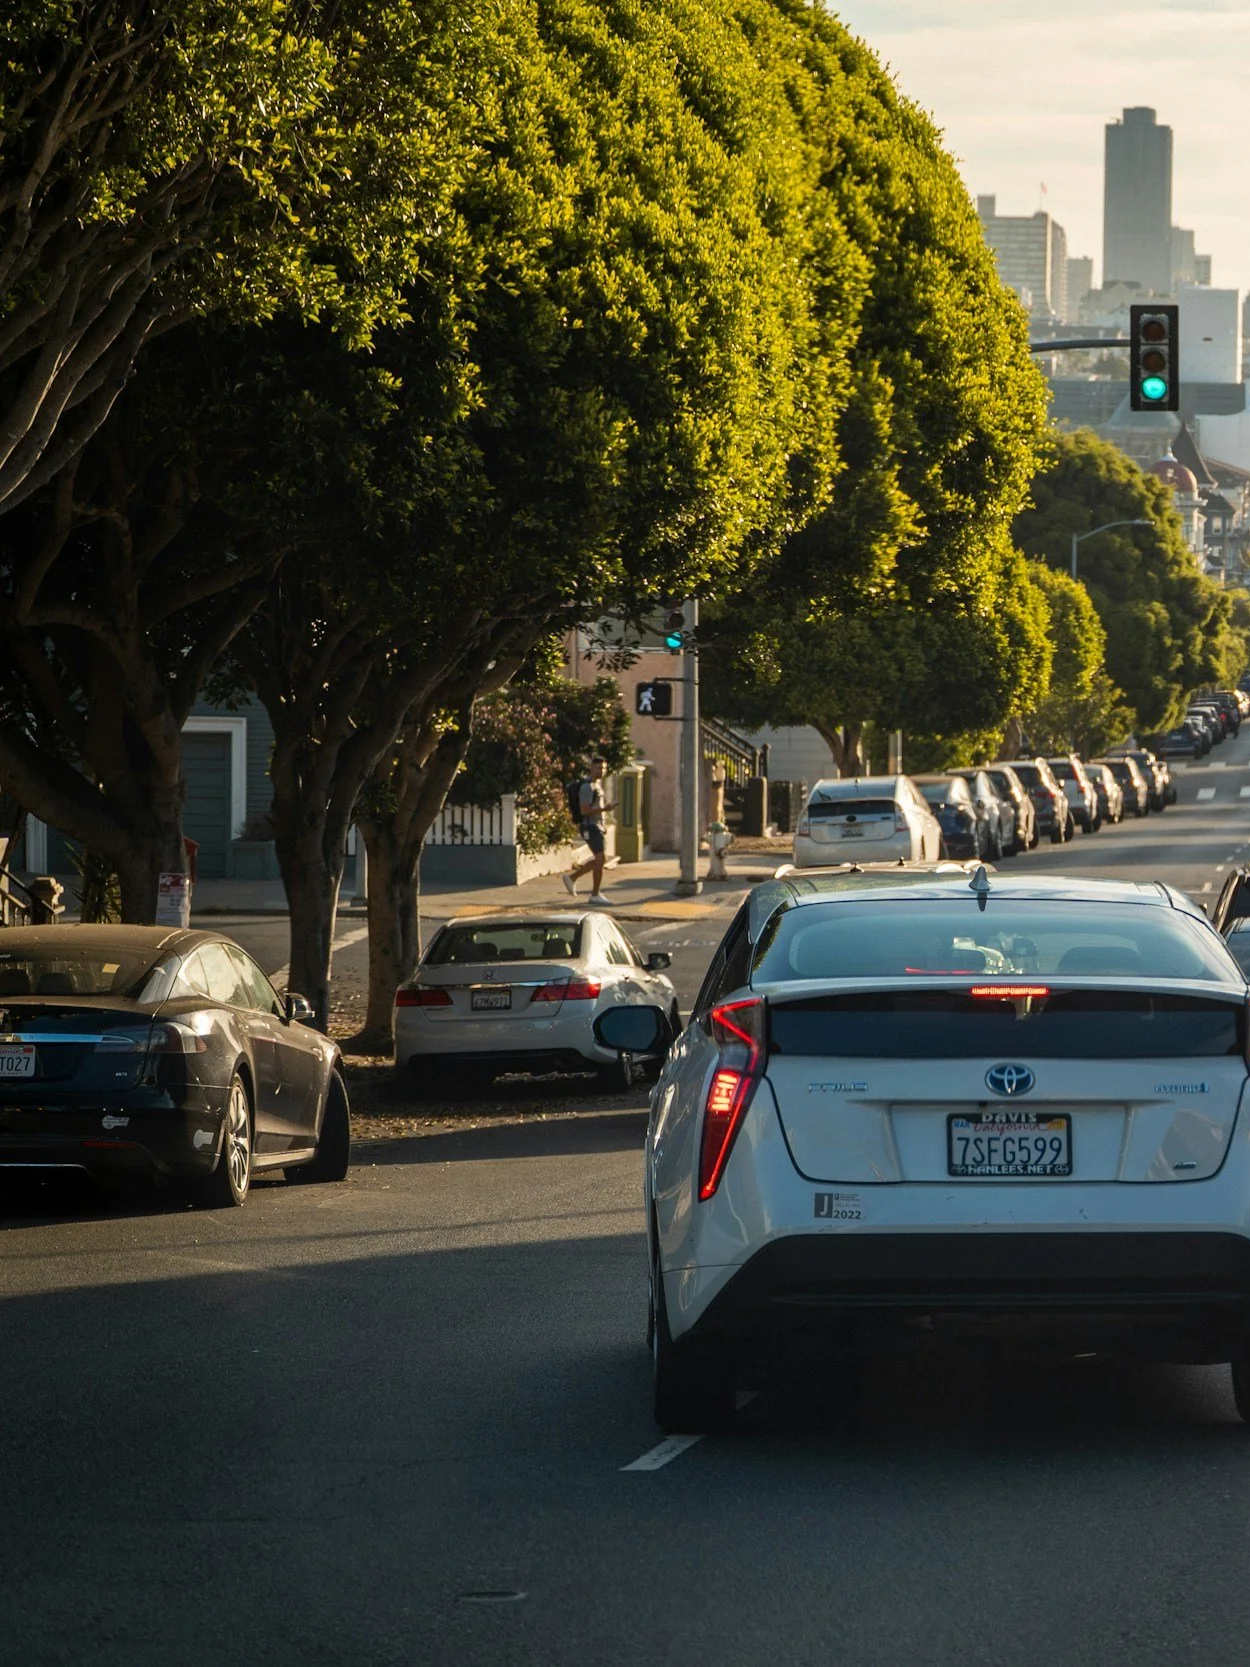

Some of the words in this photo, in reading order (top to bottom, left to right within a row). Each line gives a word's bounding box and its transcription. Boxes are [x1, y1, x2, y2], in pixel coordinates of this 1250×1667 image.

[981, 1112, 1037, 1122] DAVIS
[953, 1121, 970, 1129] MAR
[956, 1137, 1063, 1165] 7SFG599
[968, 1165, 1053, 1175] HANLEES.NET
[833, 1210, 863, 1220] 2022
